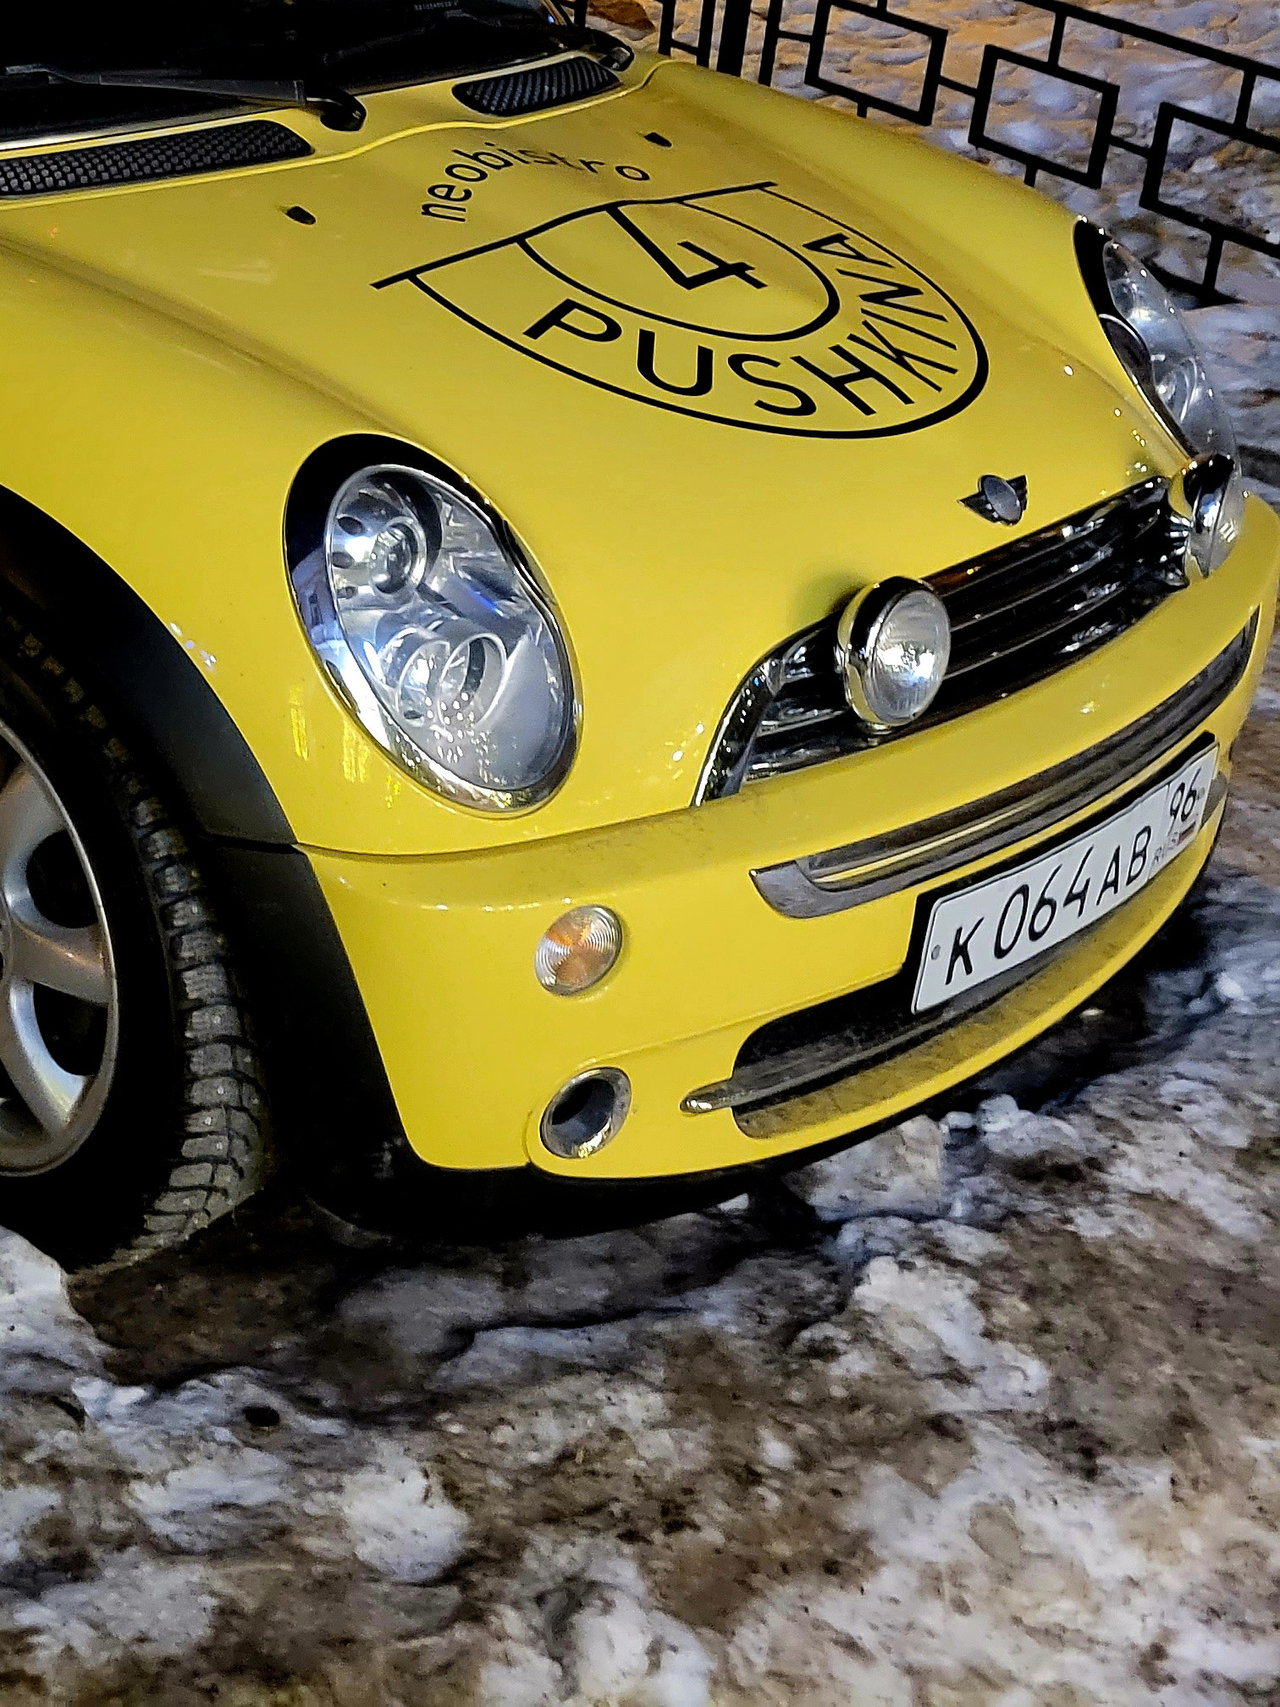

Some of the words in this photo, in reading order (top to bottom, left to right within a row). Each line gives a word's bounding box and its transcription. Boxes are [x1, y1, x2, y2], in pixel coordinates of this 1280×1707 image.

[421, 142, 650, 222] neobistro
[606, 205, 767, 290] 4
[523, 233, 959, 415] PUSHKINA
